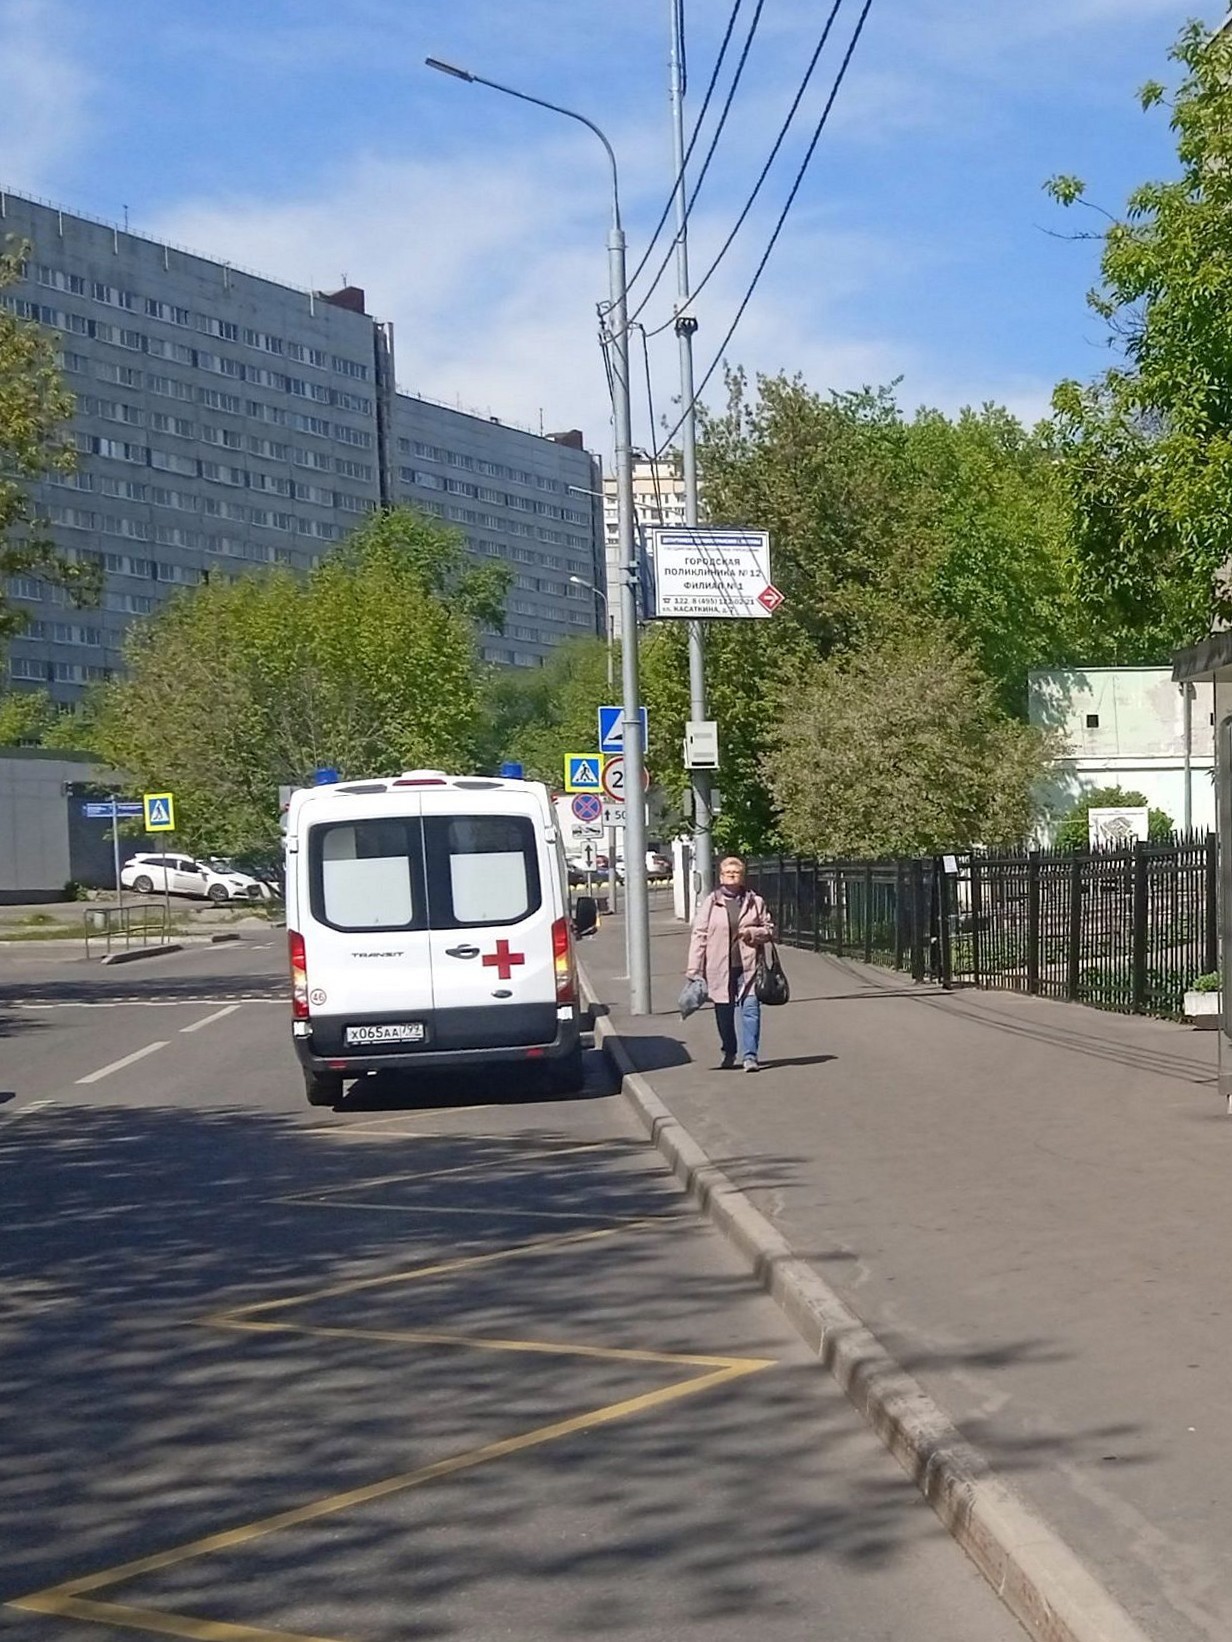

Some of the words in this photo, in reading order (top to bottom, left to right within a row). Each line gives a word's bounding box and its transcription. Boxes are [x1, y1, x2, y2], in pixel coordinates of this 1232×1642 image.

[684, 557, 741, 566] ГОРОДСКАЯ
[664, 568, 736, 577] ПОЛИКЛИНИКА
[683, 581, 724, 590] ФИЛИАЛ
